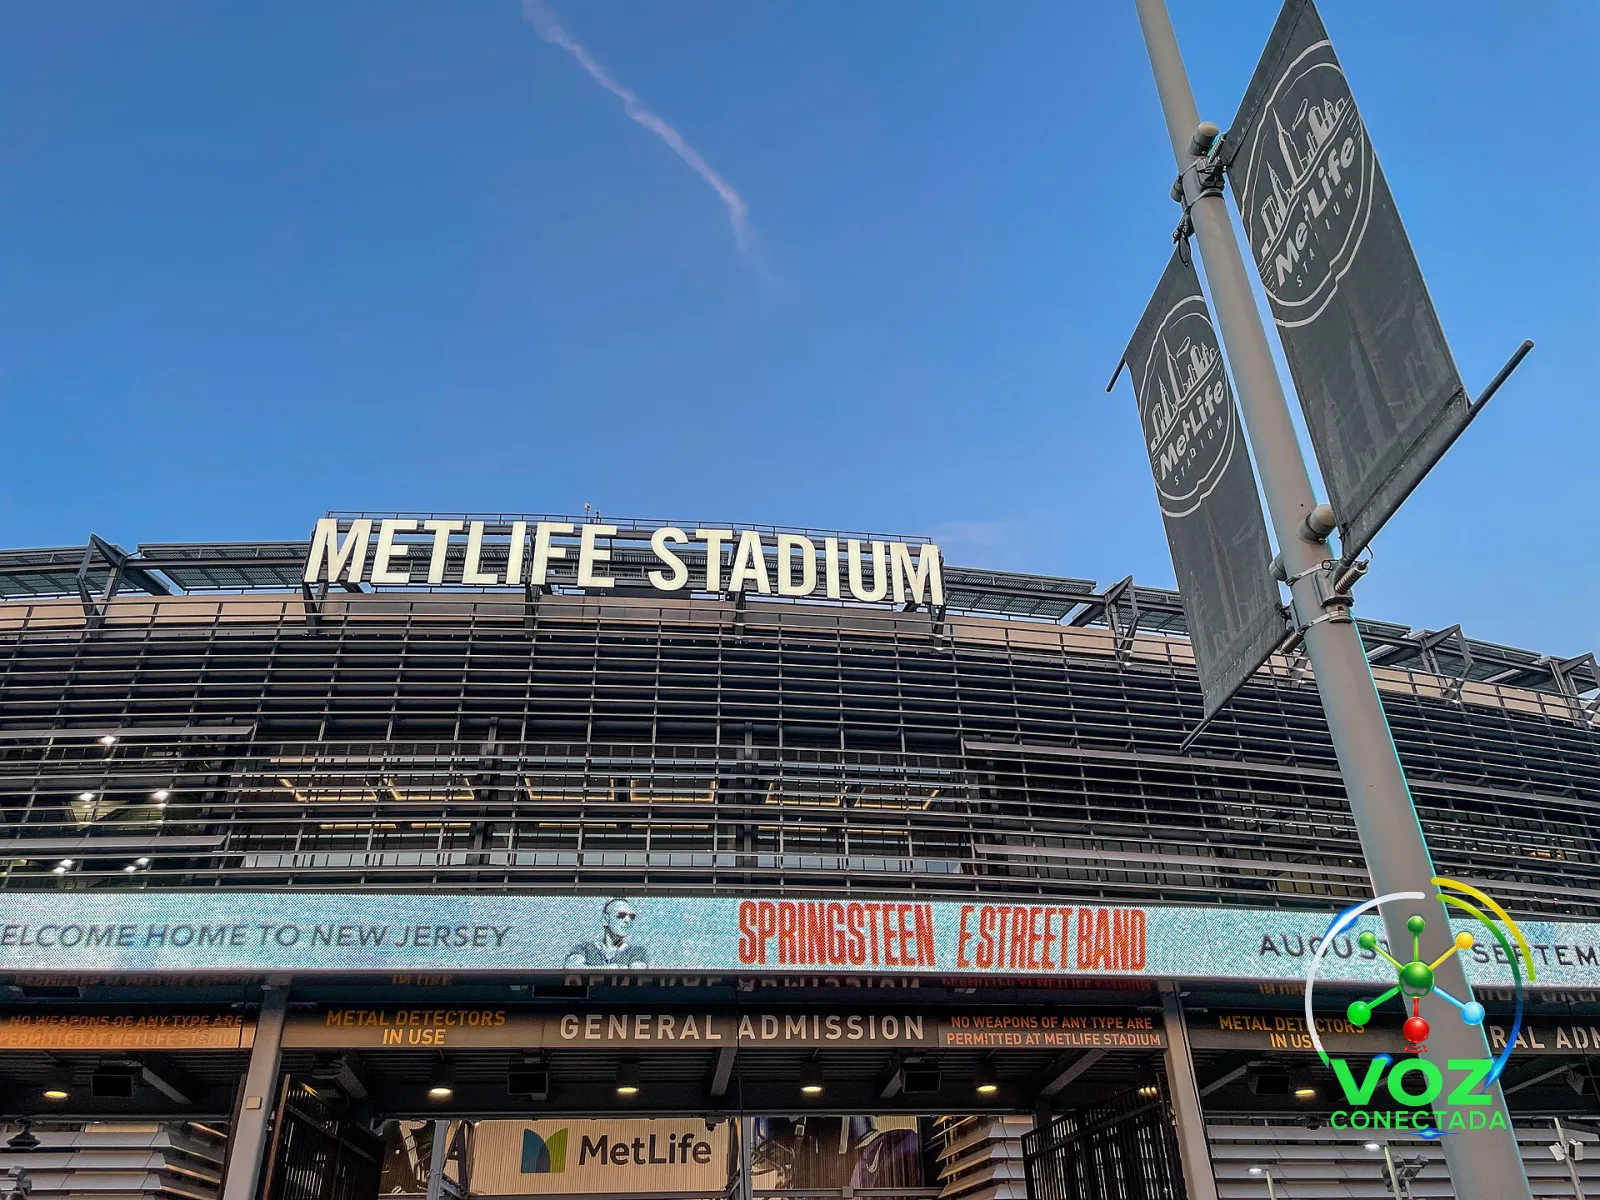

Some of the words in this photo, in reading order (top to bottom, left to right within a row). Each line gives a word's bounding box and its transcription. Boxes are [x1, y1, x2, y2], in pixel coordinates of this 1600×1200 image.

[1275, 137, 1355, 287] MetLife
[1296, 182, 1354, 287] STAIUM
[1160, 380, 1224, 481] MetLife
[1174, 416, 1223, 486] STADIUM
[303, 518, 617, 589] METLIFE
[647, 526, 945, 606] STADIUM
[0, 922, 136, 947] ELCOME
[145, 923, 247, 947] HOME
[259, 924, 300, 947] TO
[310, 924, 387, 947] NEW
[395, 924, 510, 948] JERSEY
[738, 901, 935, 967] SPRINGSTEEN
[974, 906, 1073, 969] STREET
[1076, 908, 1146, 972] BAND
[326, 1010, 391, 1026] METAL
[396, 1010, 506, 1026] DETECTORS
[560, 1015, 722, 1040] GENERAL
[736, 1015, 924, 1040] ADMISSION
[951, 1016, 970, 1028] NO
[973, 1016, 1038, 1029] WEAPONS
[1041, 1016, 1058, 1029] OF
[1062, 1016, 1092, 1029] ANY
[1092, 1017, 1123, 1029] TYPE
[1127, 1017, 1153, 1030] ARE
[1219, 1015, 1272, 1031] METAL
[1275, 1016, 1365, 1034] DETCTORS
[382, 1029, 403, 1045] IN
[408, 1029, 447, 1045] USE
[947, 1033, 1022, 1045] PERMITTED
[1026, 1033, 1041, 1045] AT
[1045, 1033, 1100, 1045] METLIFE
[1103, 1033, 1161, 1046] STADIUM
[1270, 1033, 1288, 1048] IN
[1290, 1034, 1321, 1049] US
[579, 1132, 712, 1166] MetLife
